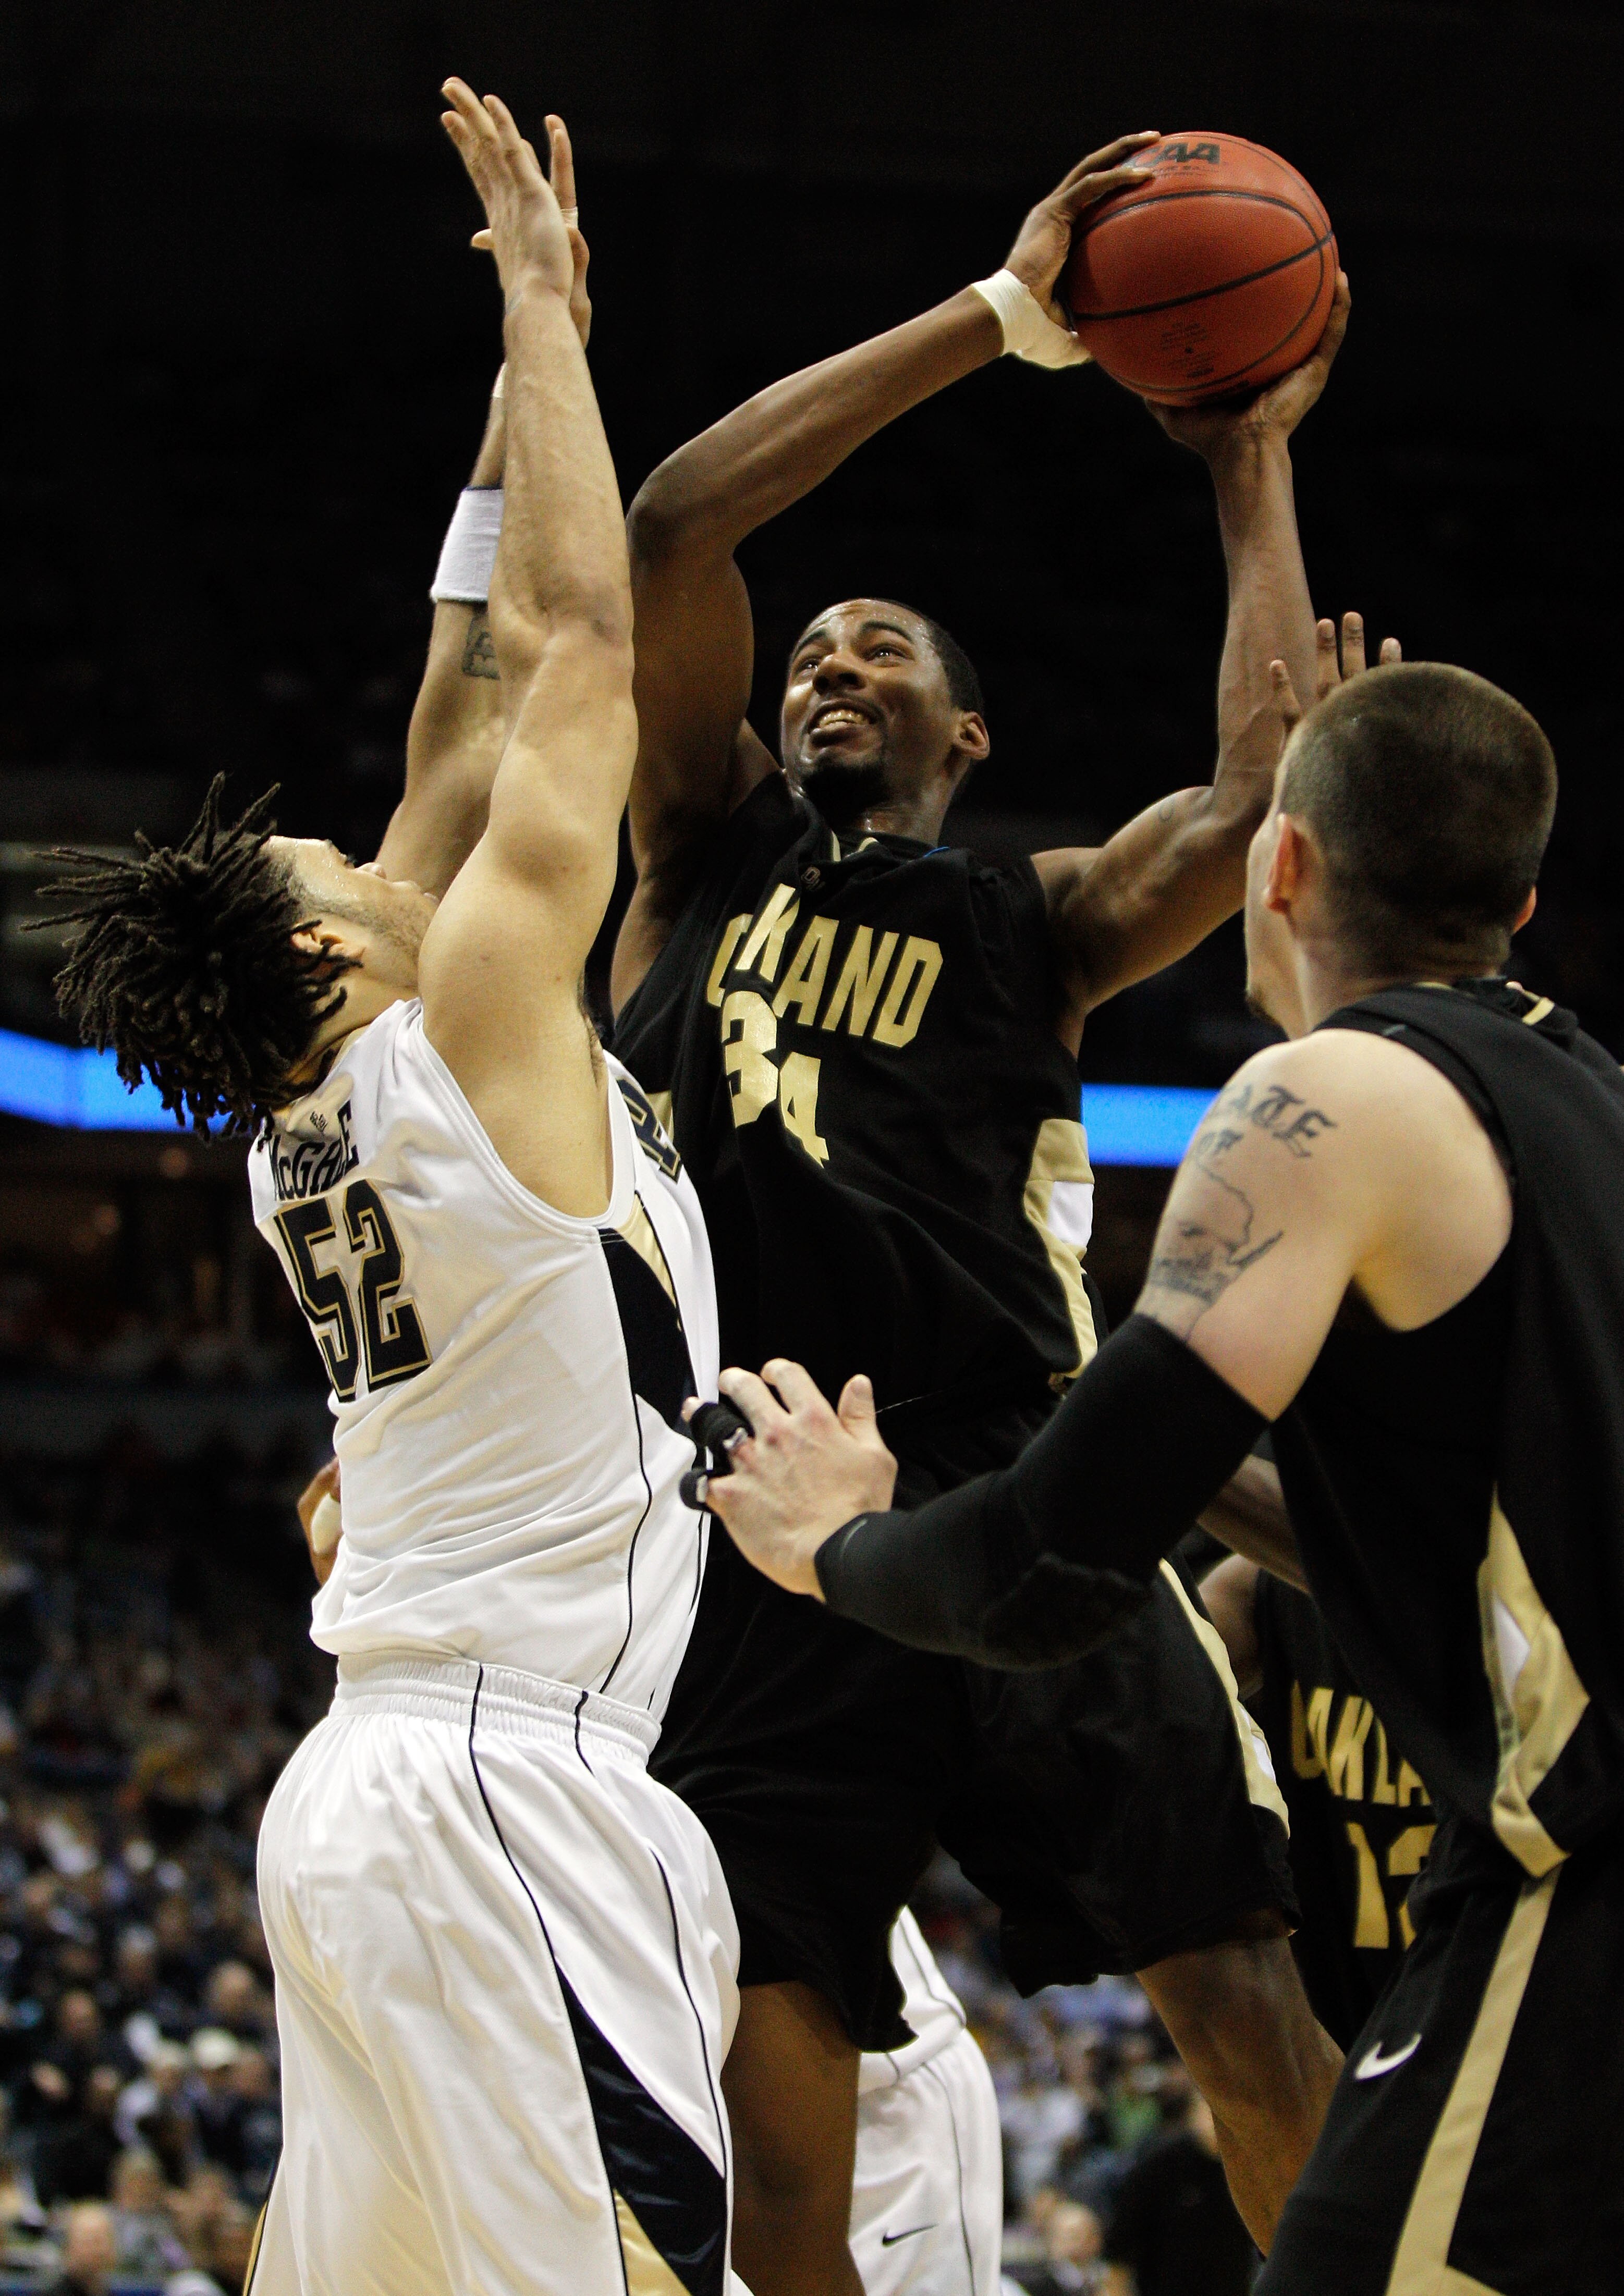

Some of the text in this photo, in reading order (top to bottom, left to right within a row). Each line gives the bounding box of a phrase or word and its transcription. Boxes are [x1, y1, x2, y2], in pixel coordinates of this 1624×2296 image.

[1122, 142, 1220, 168] CAA
[722, 991, 829, 1168] 34
[274, 1179, 434, 1404] 52
